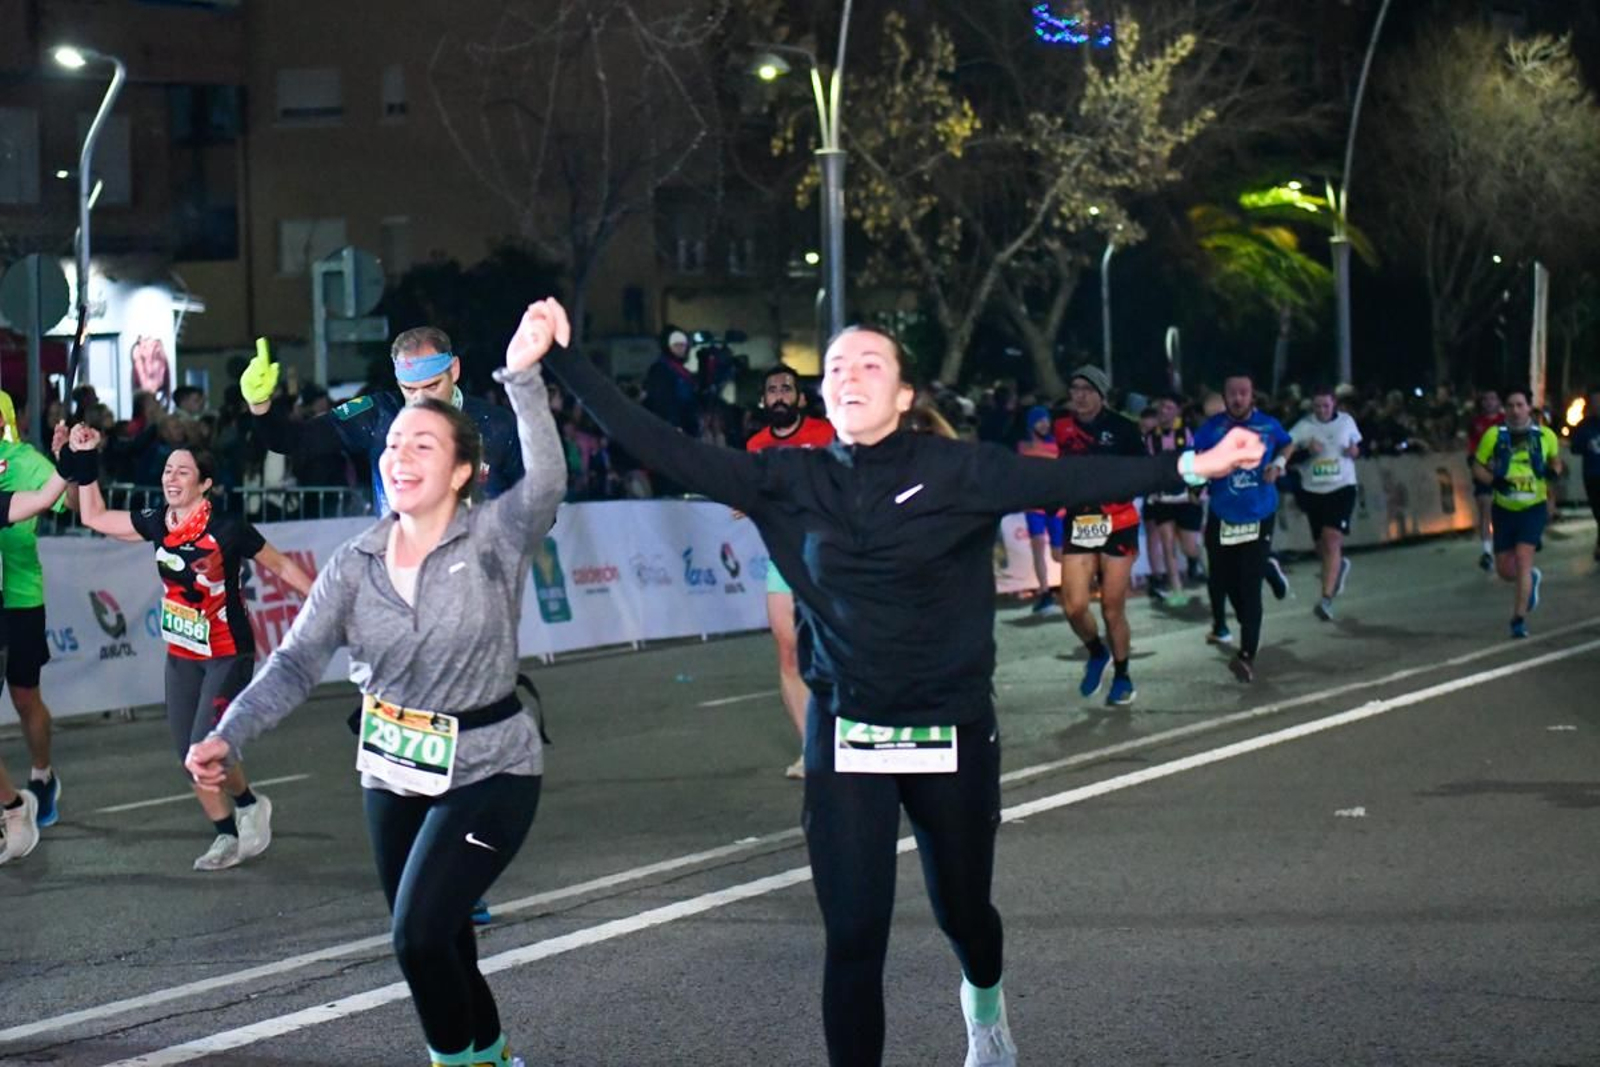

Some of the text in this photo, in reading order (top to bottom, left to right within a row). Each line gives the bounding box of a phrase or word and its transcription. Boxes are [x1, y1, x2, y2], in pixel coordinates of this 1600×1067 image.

[1076, 523, 1108, 538] 9660
[164, 612, 206, 640] 1056
[368, 717, 446, 766] 2970
